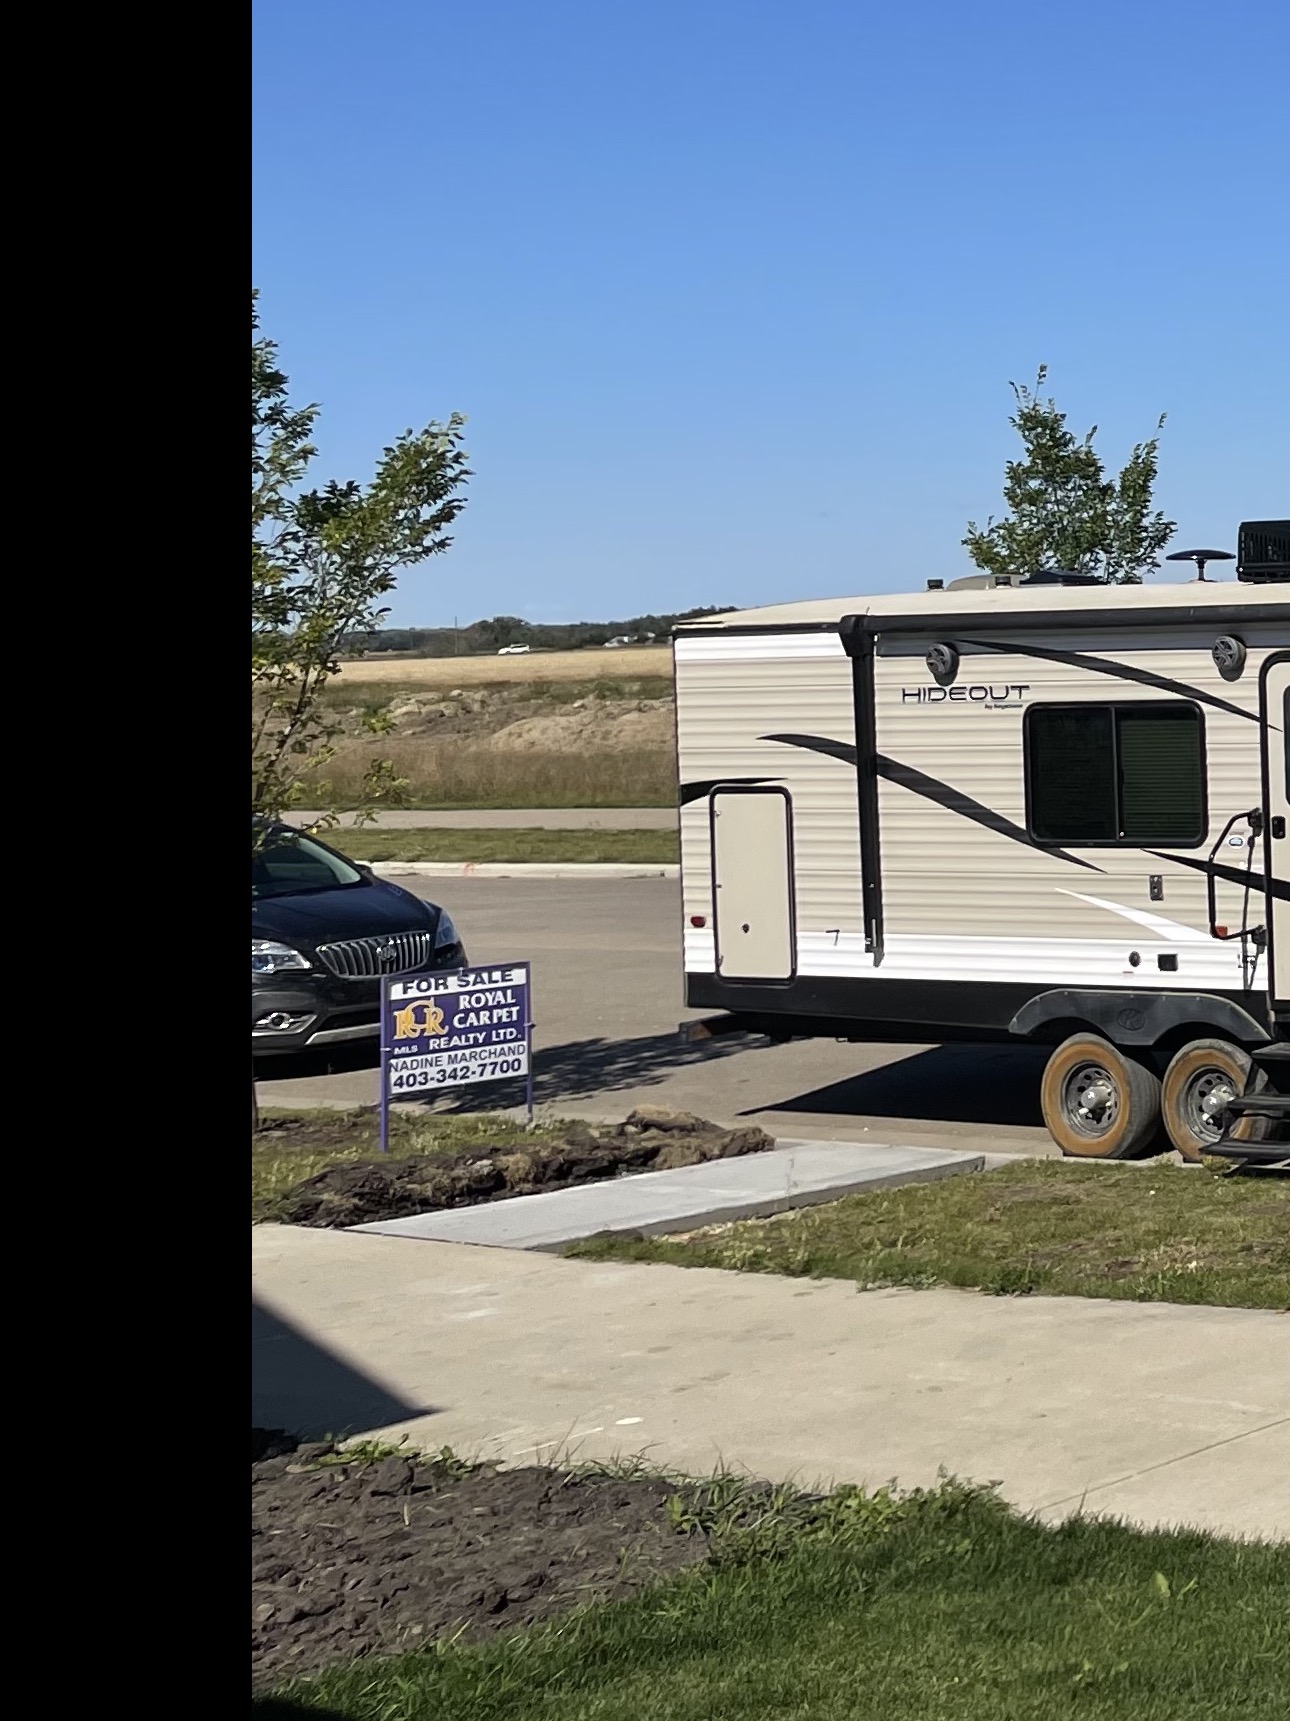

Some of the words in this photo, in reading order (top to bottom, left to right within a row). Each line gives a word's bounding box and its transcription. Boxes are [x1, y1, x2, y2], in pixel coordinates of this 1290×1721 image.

[902, 685, 1030, 704] HIDEOUT
[402, 977, 449, 995] FOR
[457, 969, 514, 988] SALE
[459, 989, 516, 1010] ROYAL
[453, 1006, 520, 1029] CARPET
[394, 1044, 418, 1055] MLS
[429, 1031, 487, 1050] REALTY
[492, 1027, 522, 1042] LTD.
[390, 1054, 443, 1073] NADINE
[447, 1043, 526, 1066] MARCHAND
[393, 1058, 522, 1089] 403-342-7700
